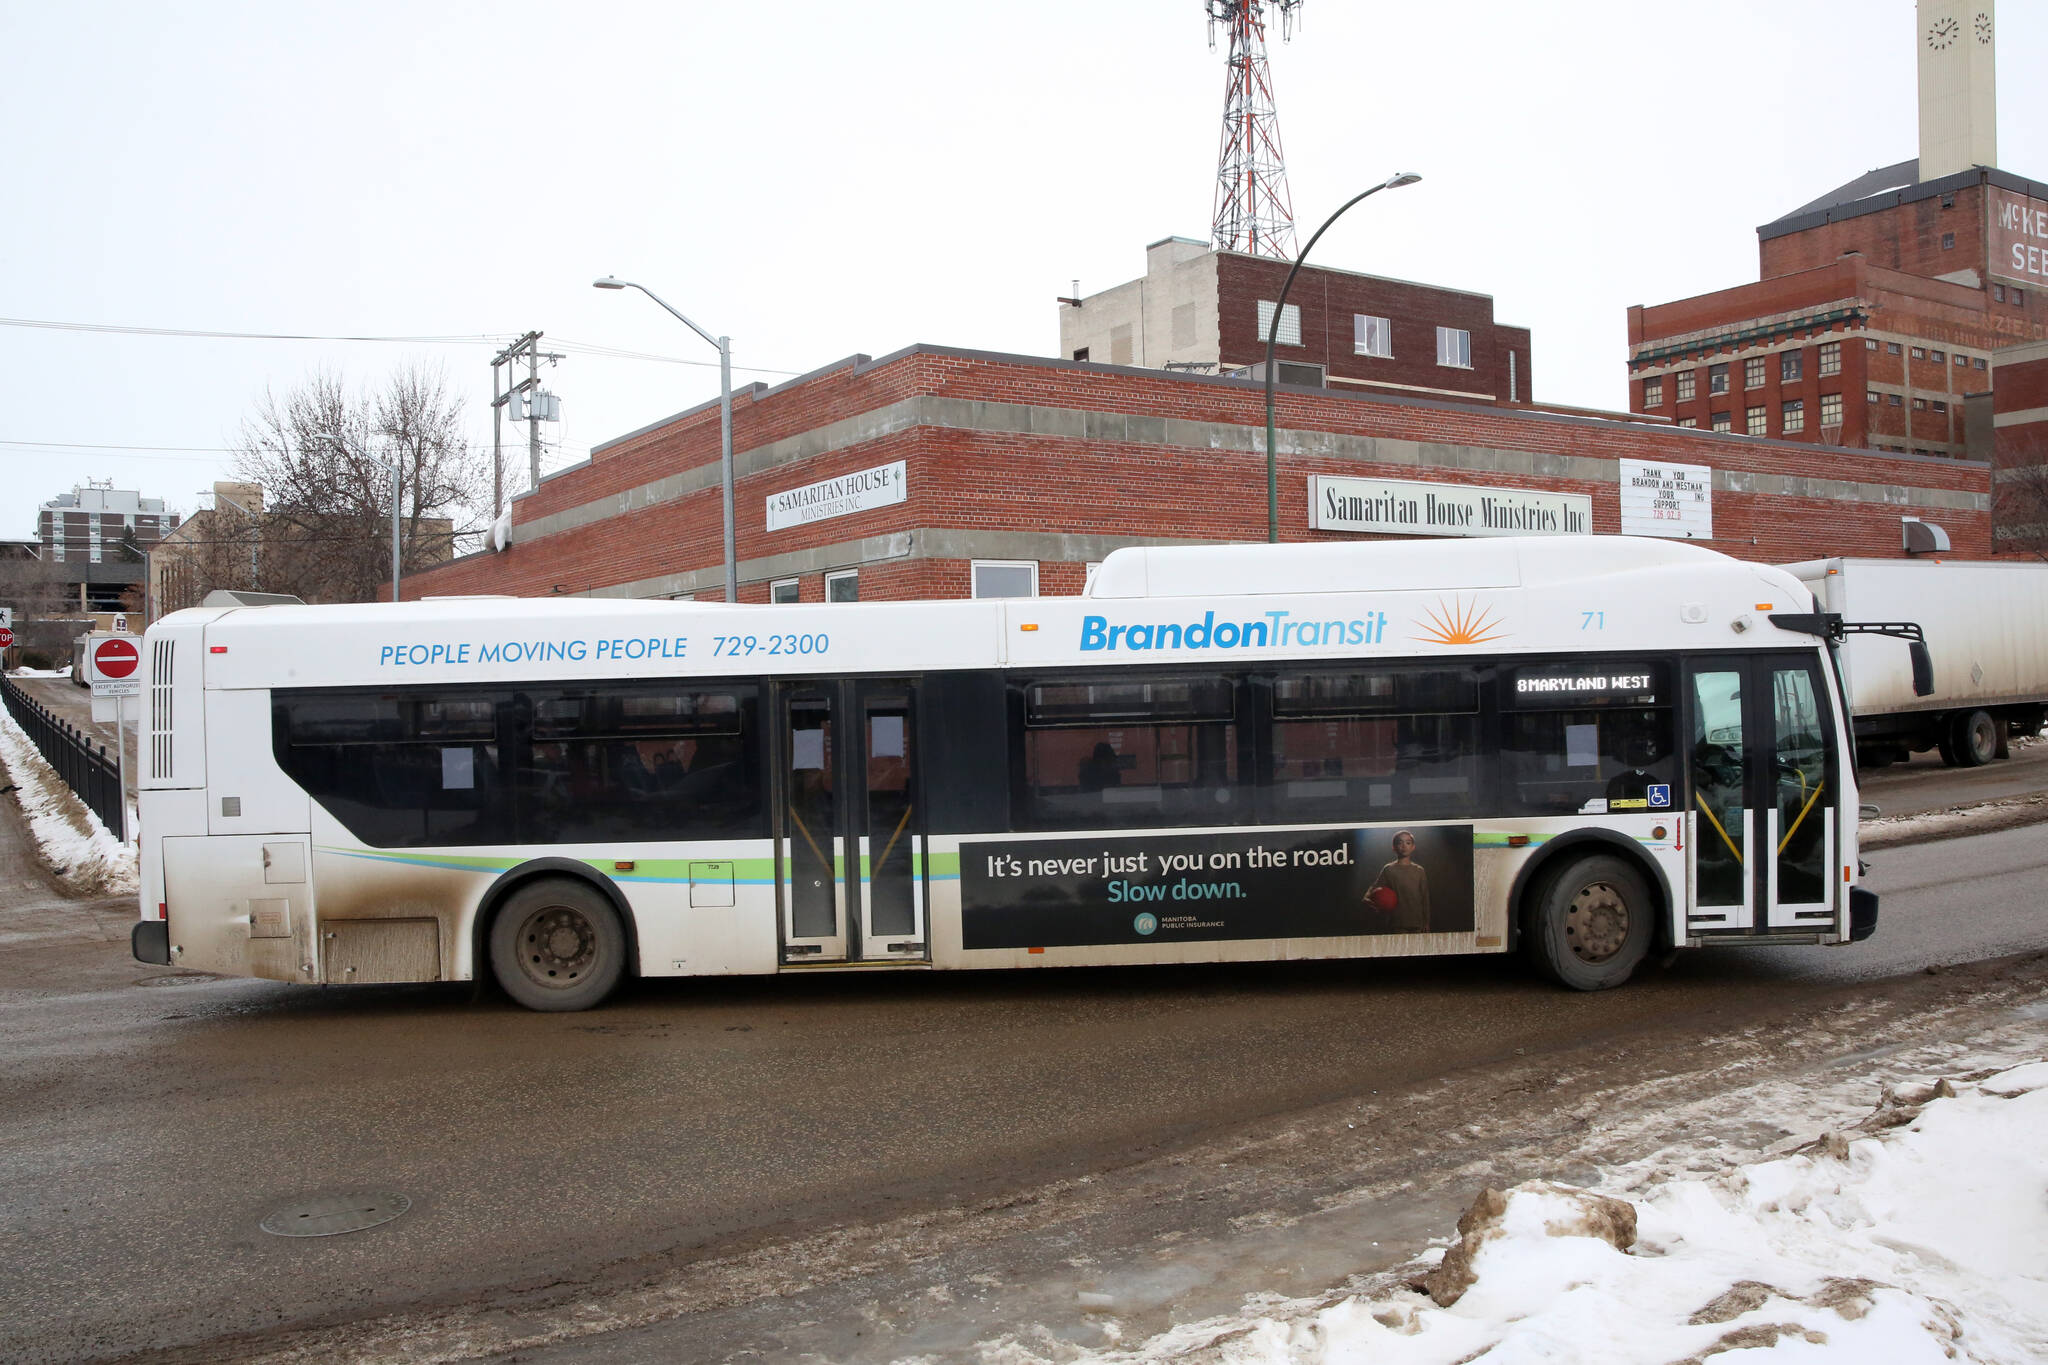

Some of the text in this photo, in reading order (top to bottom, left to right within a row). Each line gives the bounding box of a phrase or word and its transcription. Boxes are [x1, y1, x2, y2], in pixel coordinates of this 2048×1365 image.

[2012, 242, 2048, 276] SEE
[1632, 477, 1703, 492] BRANDON AND WESTMAN
[1642, 468, 1685, 480] THANK YOU
[778, 468, 889, 513] SAMARITAN HOUSE
[1658, 489, 1675, 500] YOUR
[800, 495, 863, 522] MINISTRIES INC.
[1326, 486, 1585, 533] Samaritan House Ministries Inc
[1654, 500, 1680, 510] SUPPORT
[1582, 611, 1604, 630] 71
[380, 633, 830, 666] PEOPLE MOVING PEOPLE 729-2300
[1611, 675, 1650, 689] WEST
[1028, 857, 1097, 876] never
[1101, 851, 1148, 879] just
[1158, 853, 1203, 876] you
[1209, 852, 1241, 870] on
[1246, 846, 1287, 868] the
[1293, 843, 1355, 867] road.
[1107, 878, 1247, 903] Slow down.
